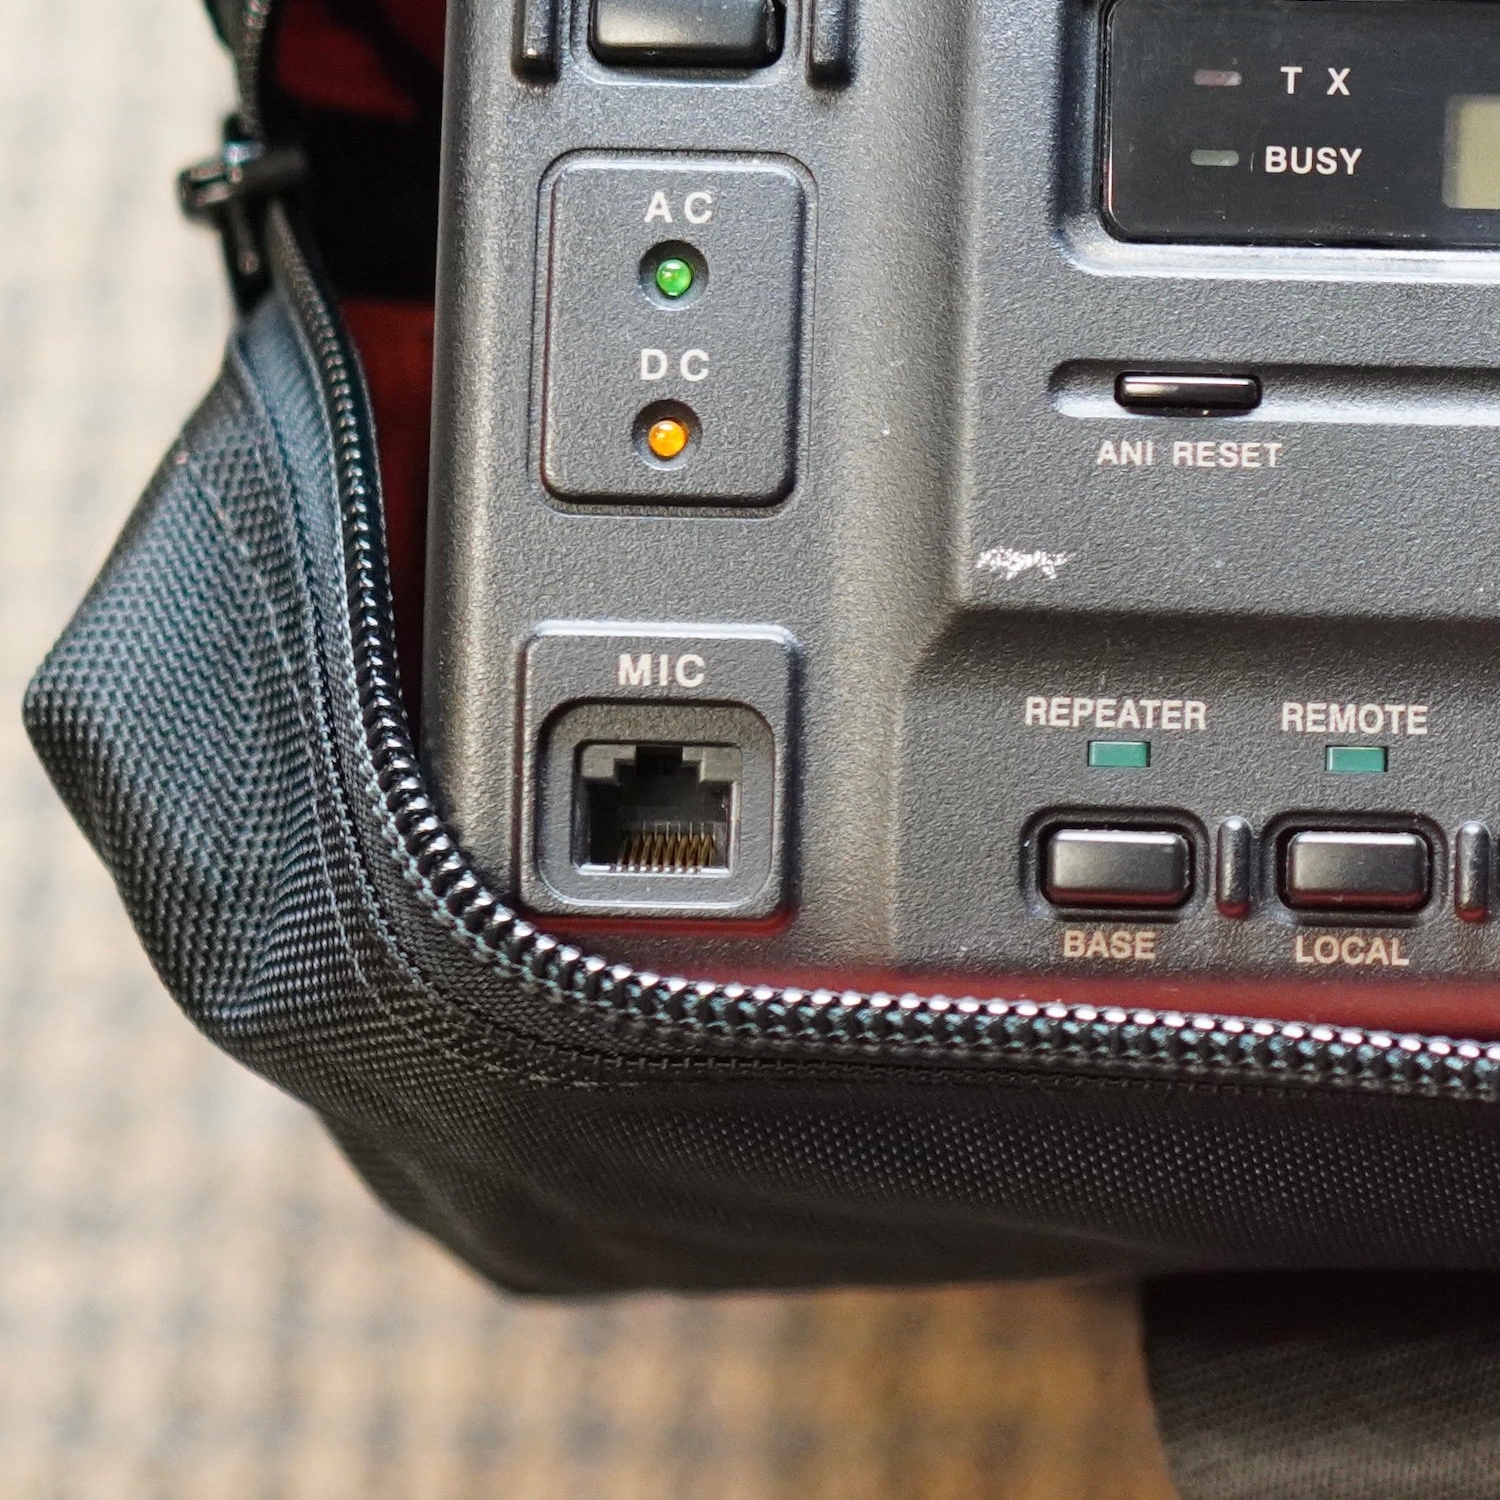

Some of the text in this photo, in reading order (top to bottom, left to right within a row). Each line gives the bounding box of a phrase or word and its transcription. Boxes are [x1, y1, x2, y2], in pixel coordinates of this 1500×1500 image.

[1264, 146, 1362, 176] BUSY
[644, 192, 714, 224] AC
[640, 349, 709, 381] DC
[1097, 440, 1284, 468] ANI RESET
[618, 653, 706, 688] MIC
[1024, 698, 1208, 732] REPEATER
[1280, 701, 1429, 736] REMOTE
[1062, 930, 1157, 961] BASE
[1295, 936, 1410, 967] LOCAL
